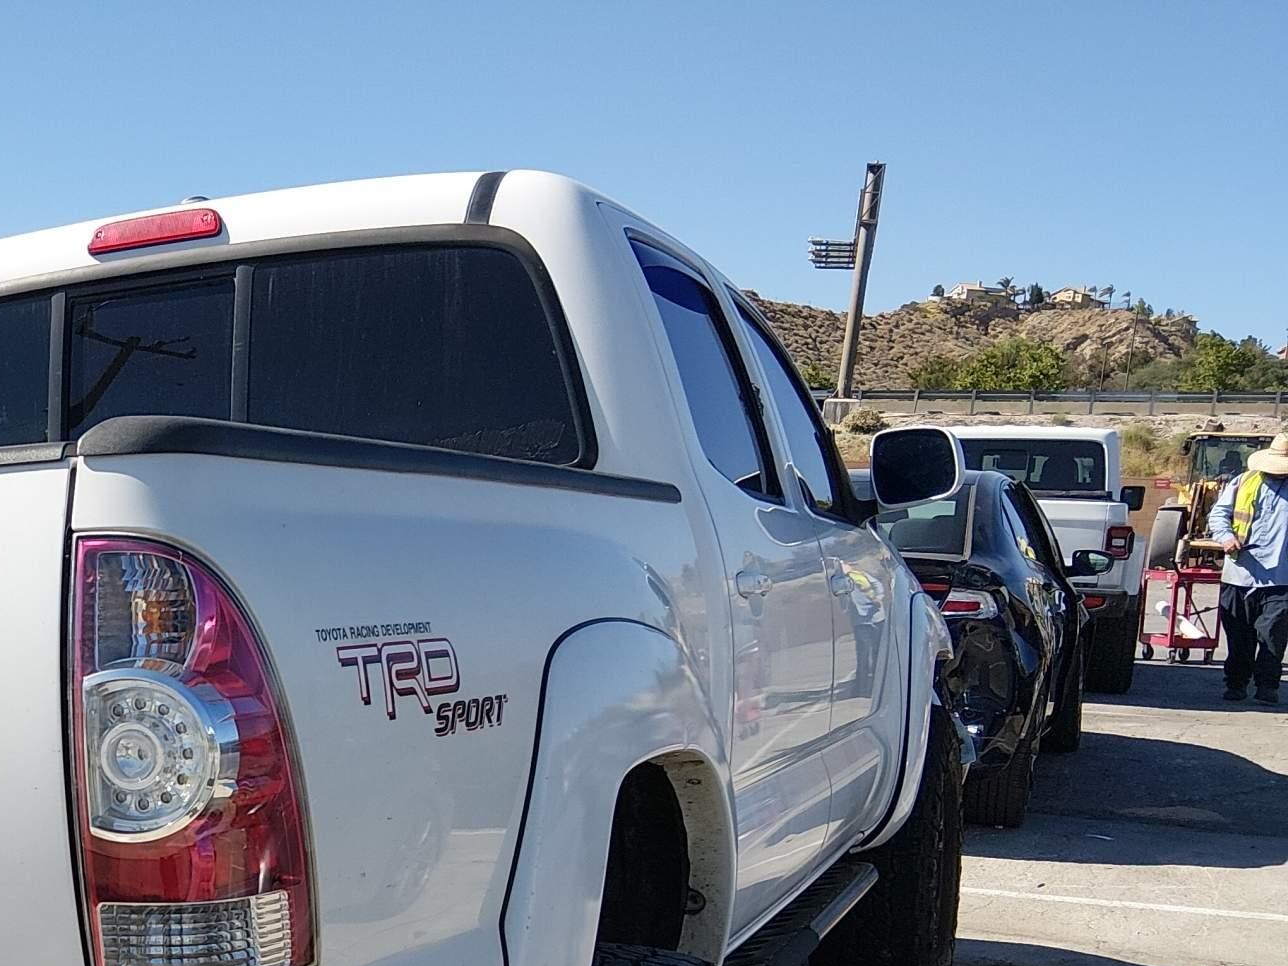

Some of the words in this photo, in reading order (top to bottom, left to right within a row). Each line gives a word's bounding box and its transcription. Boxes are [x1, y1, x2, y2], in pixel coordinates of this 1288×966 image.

[315, 628, 349, 642] TOYOTA
[349, 624, 379, 640] RACING
[381, 621, 432, 637] DEVELOPMENT
[336, 637, 461, 720] TRD
[434, 694, 506, 737] SPORT
